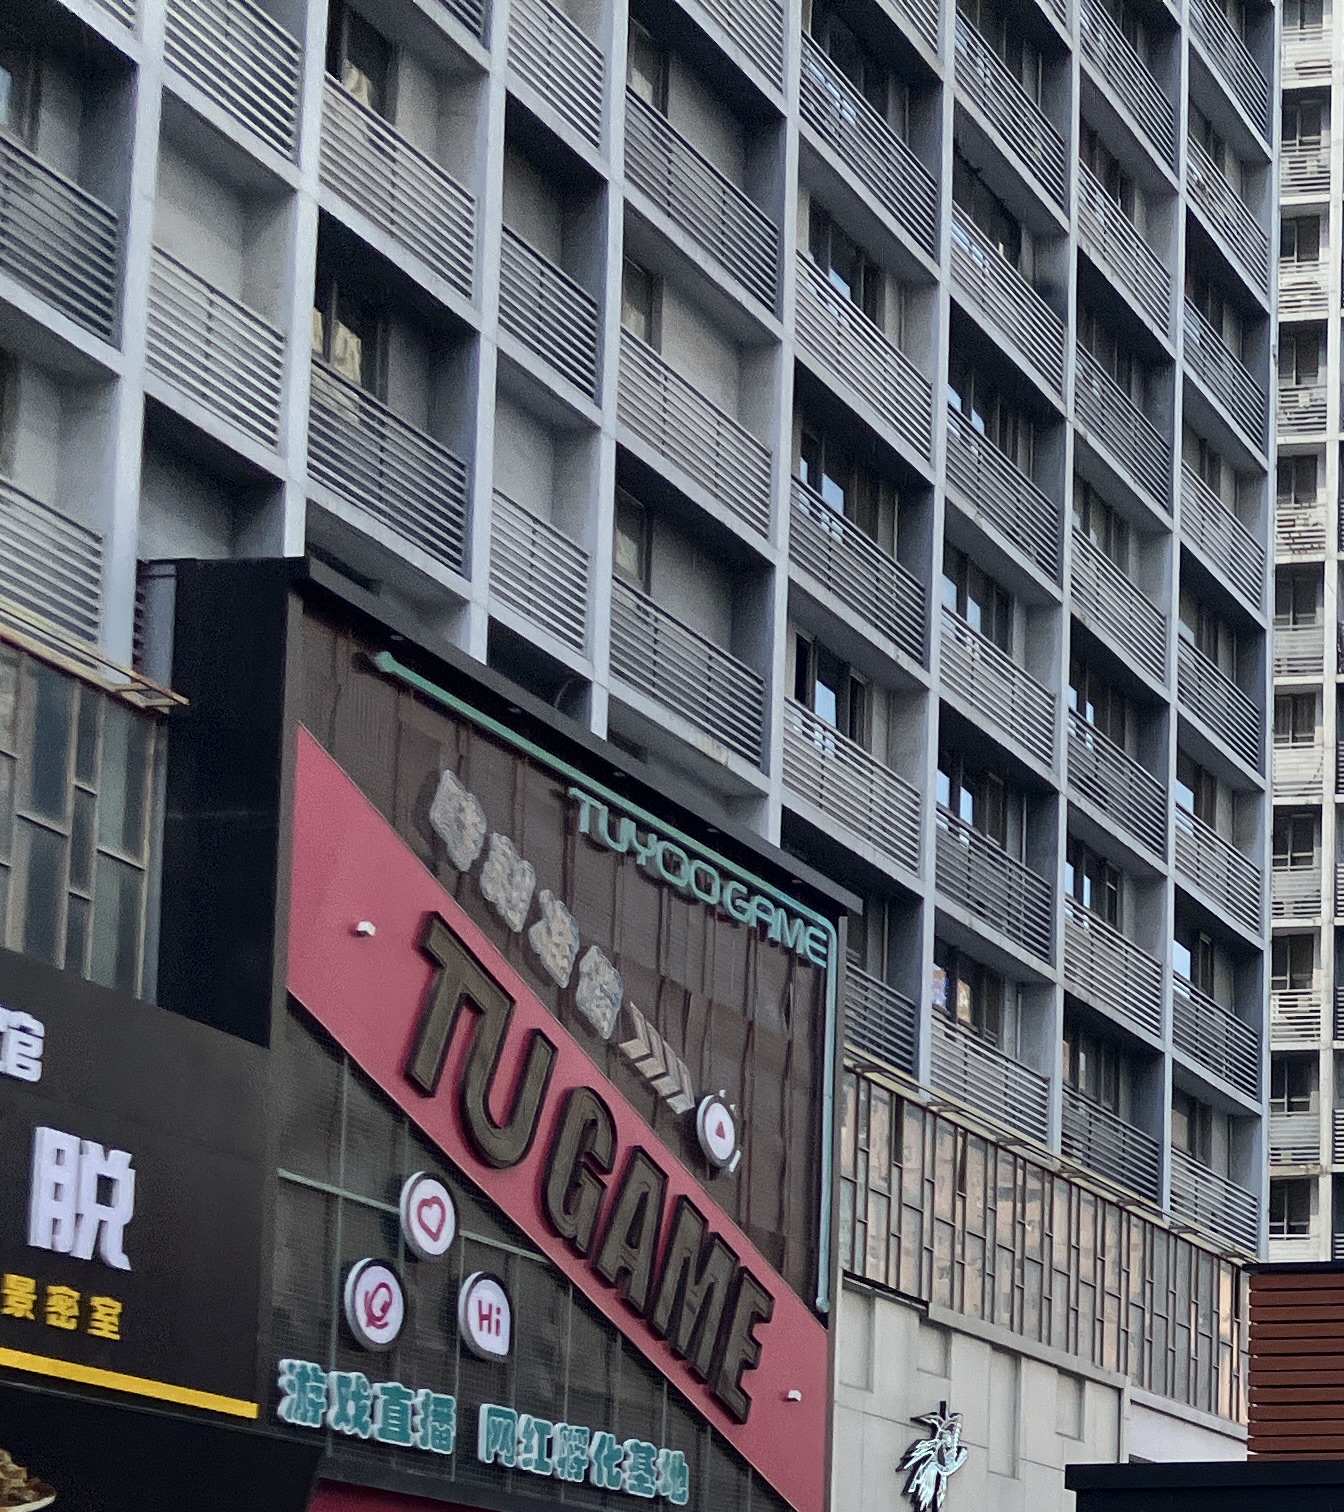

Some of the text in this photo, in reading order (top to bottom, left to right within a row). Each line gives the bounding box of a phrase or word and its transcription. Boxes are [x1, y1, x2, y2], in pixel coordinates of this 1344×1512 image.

[278, 1358, 690, 1506] 游戏直播 网红孵化基地
